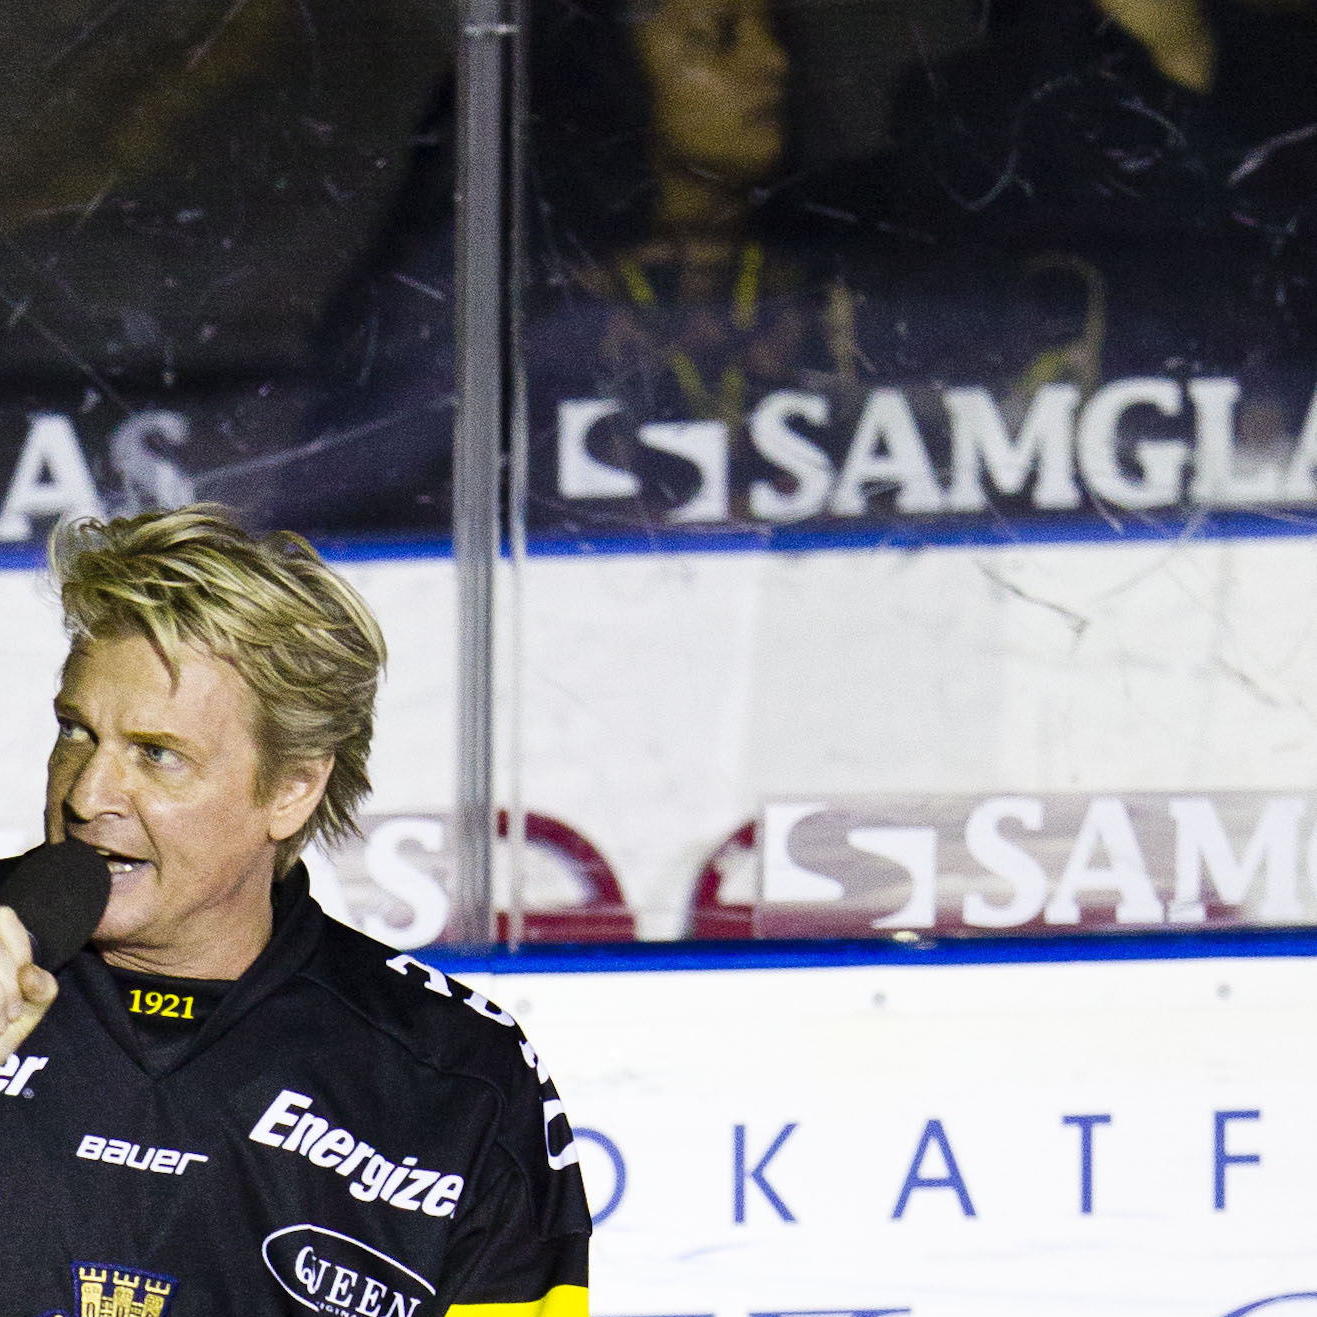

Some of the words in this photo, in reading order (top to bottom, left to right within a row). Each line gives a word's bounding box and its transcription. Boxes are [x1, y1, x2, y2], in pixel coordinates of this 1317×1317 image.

[962, 796, 1317, 926] SAM
[129, 989, 195, 1020] 1921
[248, 1089, 465, 1220] Energize
